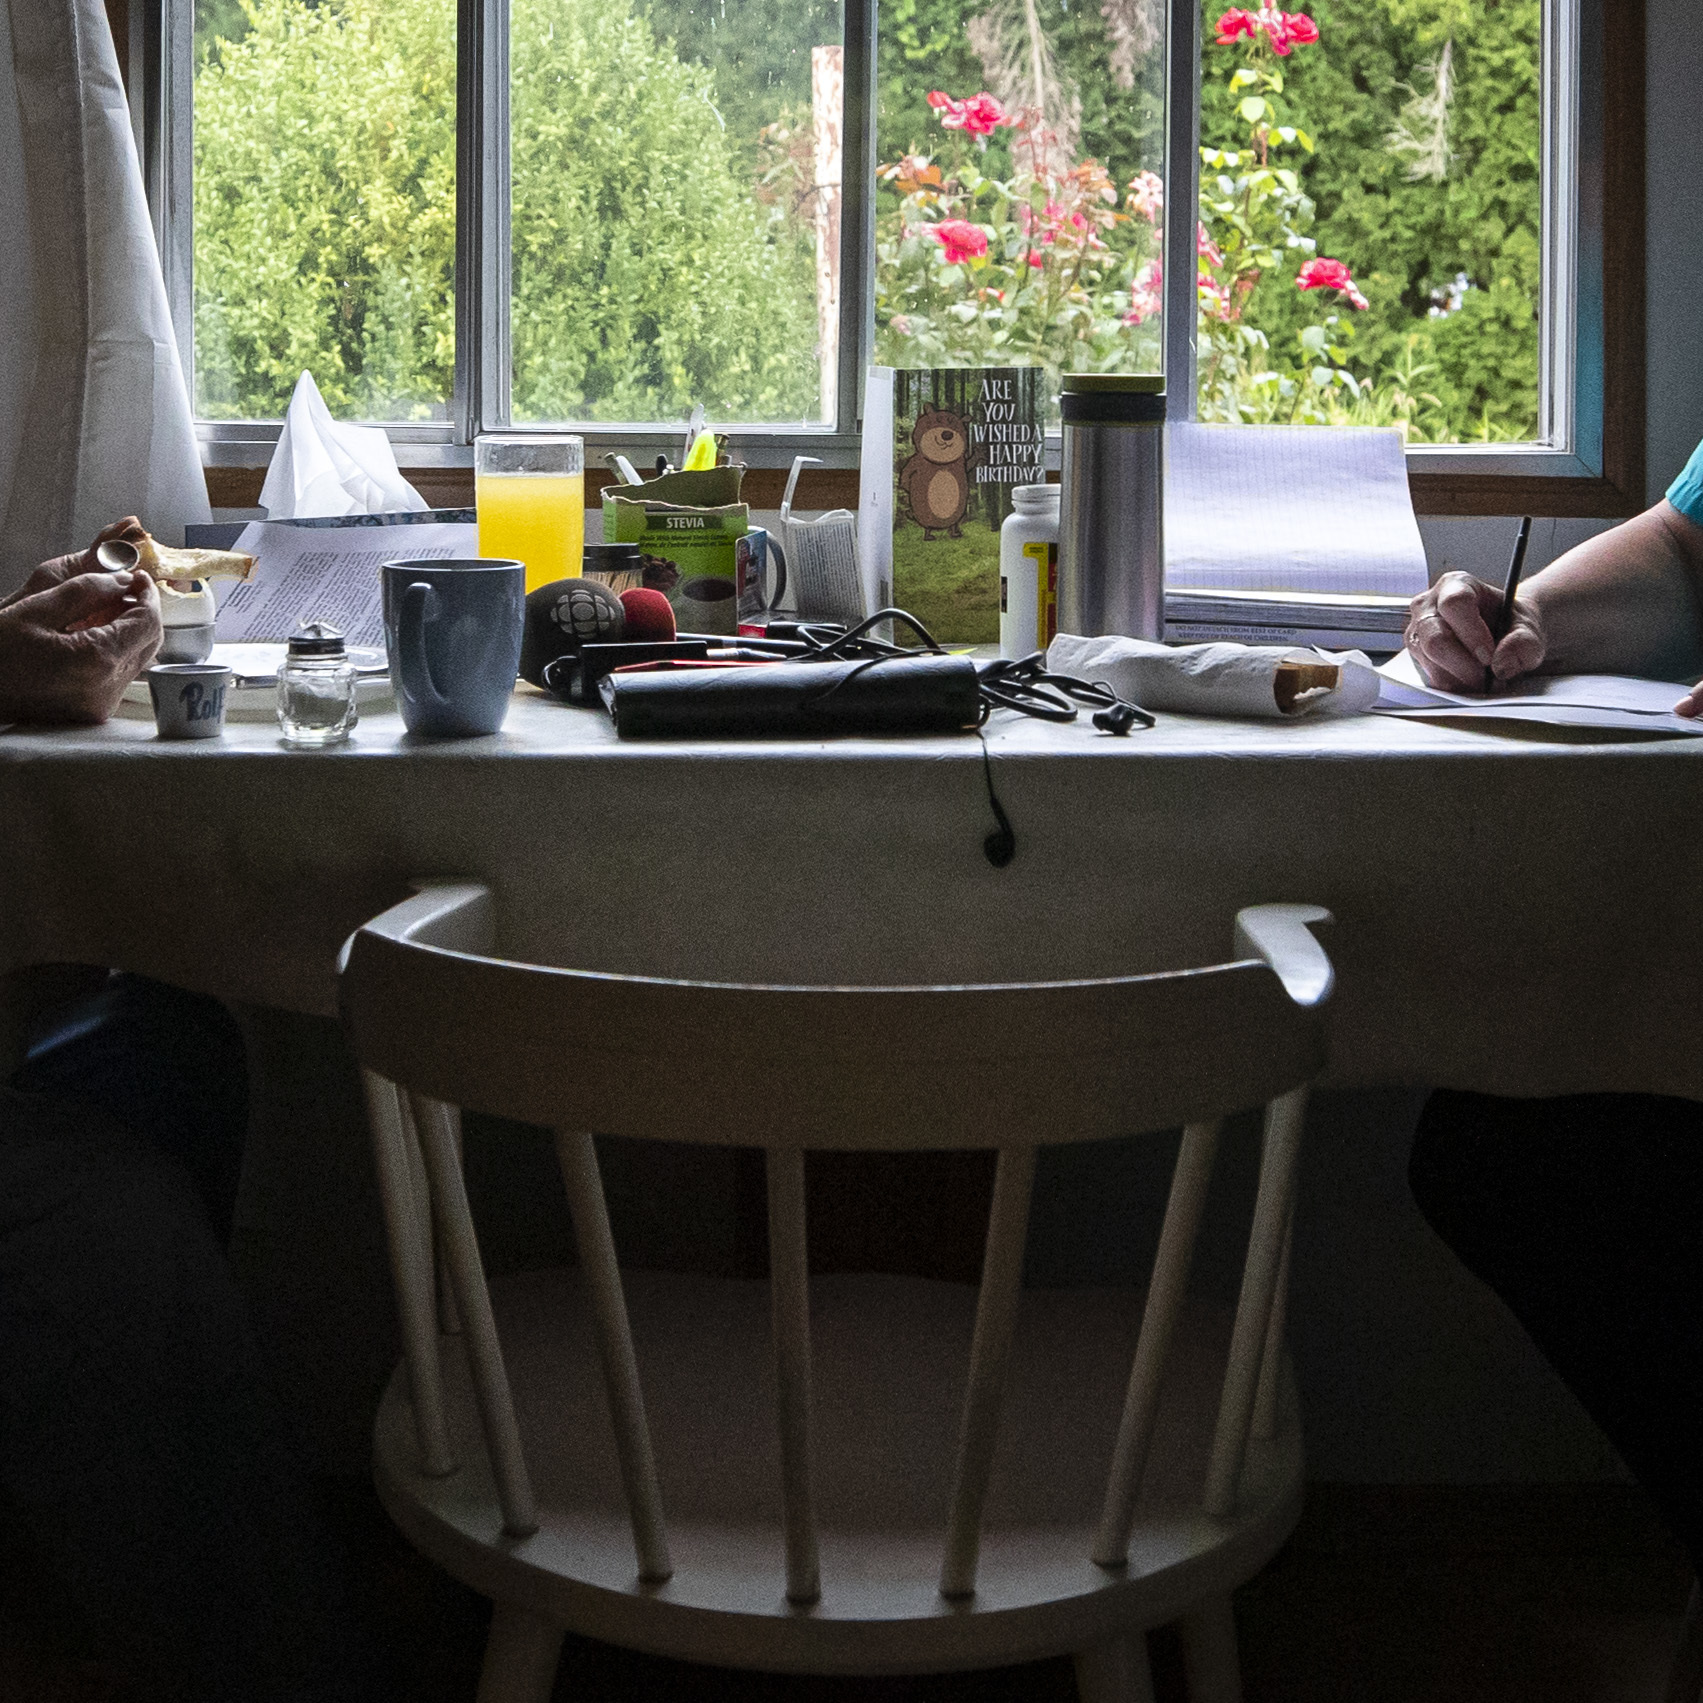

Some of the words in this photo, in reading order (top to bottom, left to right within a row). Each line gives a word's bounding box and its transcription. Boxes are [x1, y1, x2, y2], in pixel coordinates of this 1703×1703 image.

[978, 379, 1012, 401] ARE
[981, 401, 1016, 423] YOU
[973, 423, 1031, 443] WISHED
[1031, 423, 1043, 443] A
[989, 443, 1044, 465] HAPPY
[975, 465, 1045, 483] BIRTHDAY?
[666, 517, 705, 529] STEVIA
